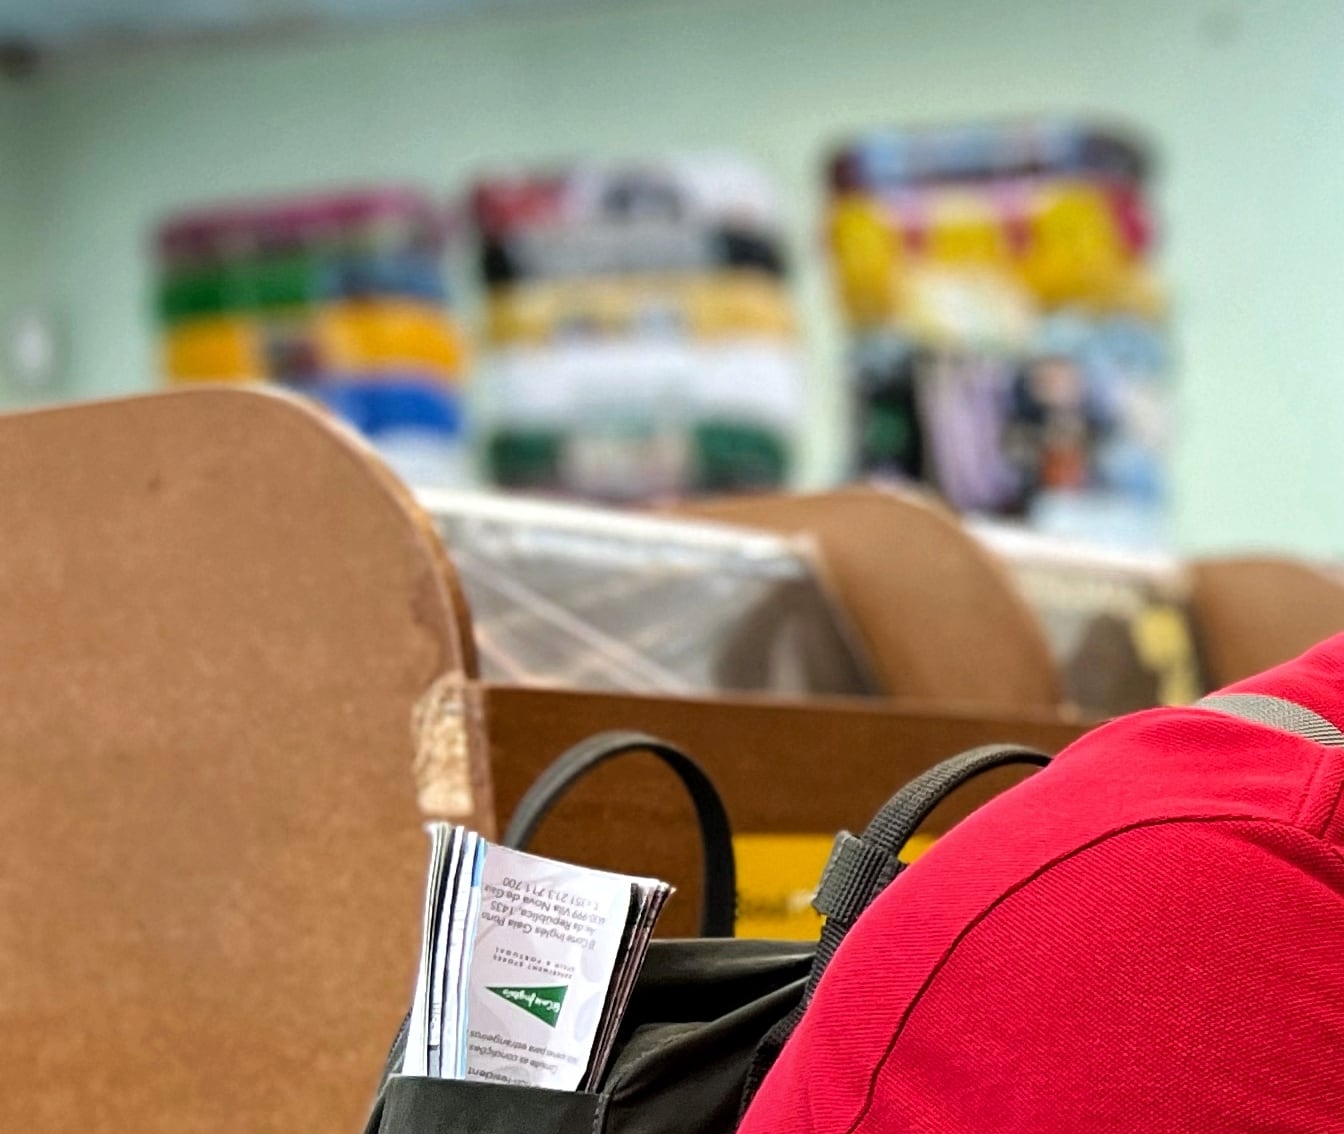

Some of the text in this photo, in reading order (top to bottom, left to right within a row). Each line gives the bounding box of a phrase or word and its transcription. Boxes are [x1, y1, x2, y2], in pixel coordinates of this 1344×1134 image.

[502, 876, 522, 891] 700
[505, 892, 521, 902] de
[523, 895, 551, 912] Nova
[490, 900, 514, 916] 1435
[553, 904, 571, 917] Vila
[481, 911, 506, 927] Porto
[507, 917, 533, 934] Gaia
[534, 925, 566, 943] Inglés
